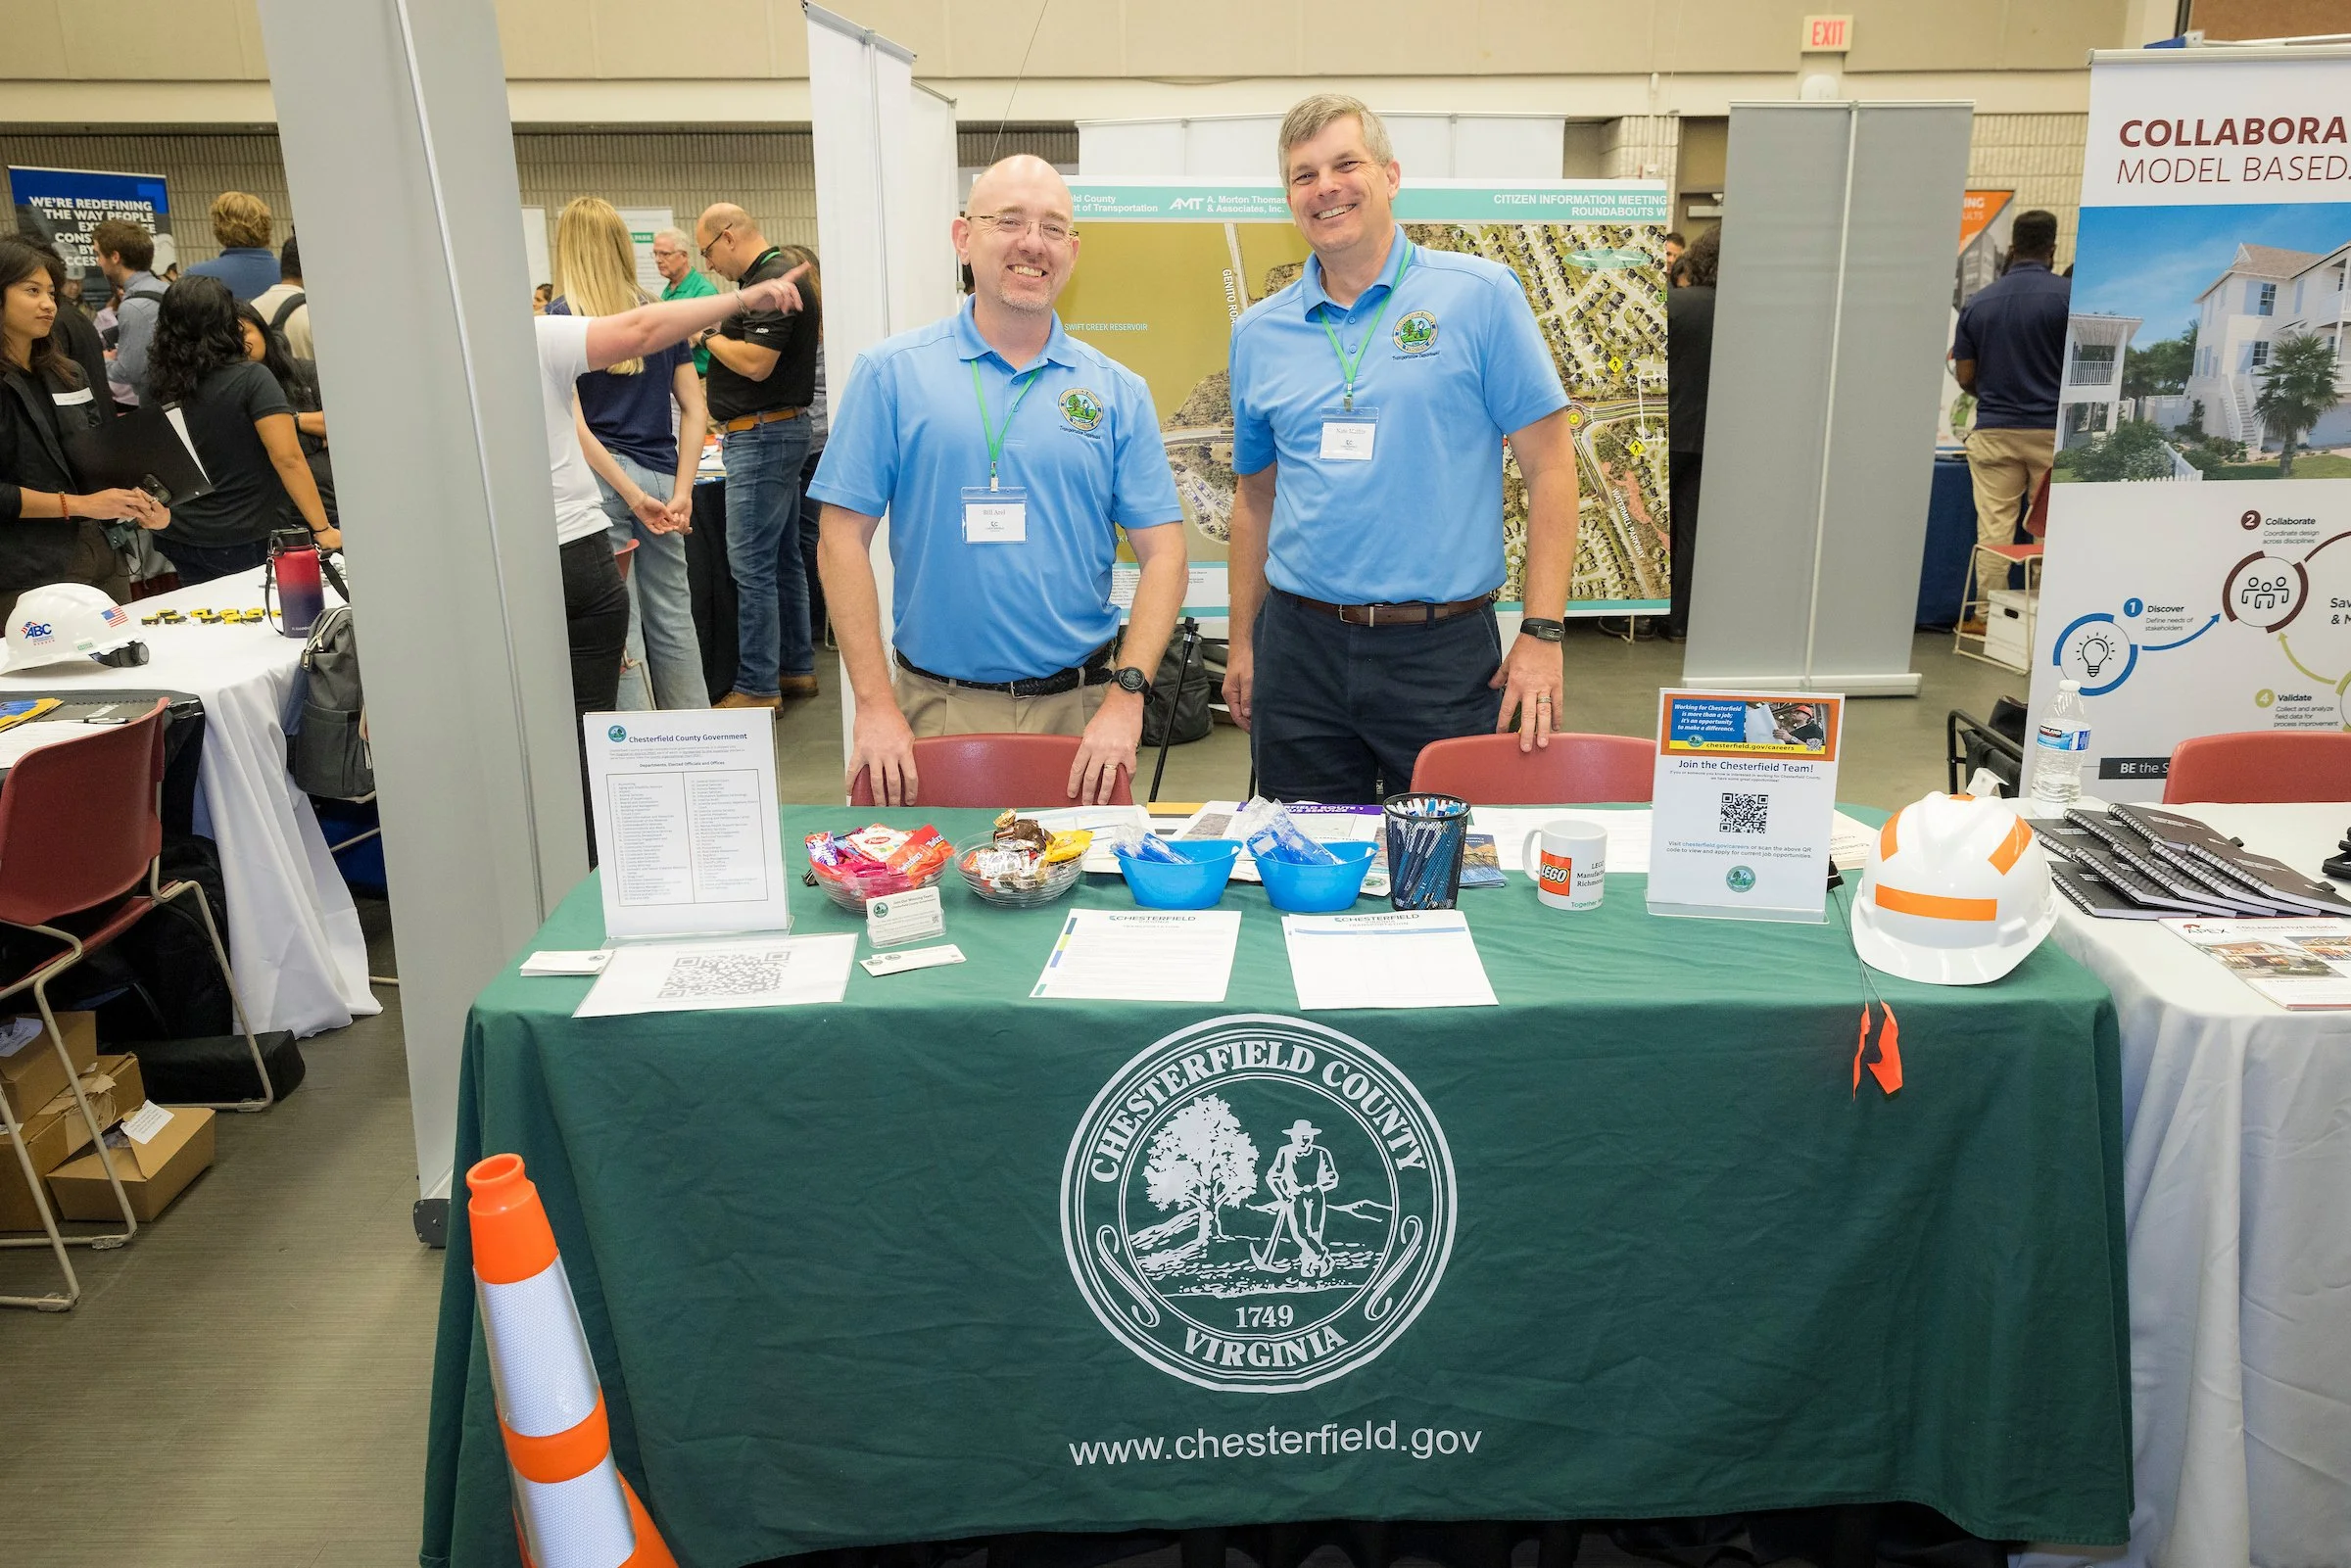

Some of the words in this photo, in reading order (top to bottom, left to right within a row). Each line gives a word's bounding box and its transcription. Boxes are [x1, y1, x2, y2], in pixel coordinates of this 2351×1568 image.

[1812, 21, 1846, 46] EXIT
[2117, 158, 2231, 184] MODEL
[28, 196, 73, 209] WE'RE
[75, 199, 153, 212] REDEFINING
[1085, 195, 1116, 204] County
[1169, 197, 1204, 211] AMT
[1218, 195, 1249, 204] Morton
[1251, 195, 1286, 204] Thomas
[1494, 195, 1537, 204] CITIZEN
[1539, 195, 1614, 205] INFORMATION
[1618, 195, 1666, 205] MEETING
[1083, 203, 1092, 212] of
[1093, 204, 1158, 213] Transportation
[1216, 205, 1268, 214] Associates,
[1571, 207, 1654, 216] ROUNDABOUTS
[43, 209, 72, 219] THE
[73, 210, 104, 221] WAY
[107, 211, 154, 222] PEOPLE
[79, 245, 95, 256] BY
[1222, 268, 1237, 303] GENITO
[1611, 488, 1631, 528] WATERMILL
[1627, 526, 1646, 559] PARKWAY
[2245, 514, 2256, 527] 2
[2265, 517, 2317, 526] Collaborate
[2146, 604, 2184, 614] Discover
[2331, 614, 2340, 625] &
[24, 623, 52, 639] ABC
[2259, 692, 2269, 704] 4
[629, 735, 674, 743] Chesterfield
[675, 735, 701, 744] County
[702, 733, 747, 741] Government
[1705, 742, 1795, 751] chesterfield.gov/careers
[1678, 760, 1698, 769] Join
[1701, 760, 1717, 770] the
[1720, 761, 1779, 772] Chesterfield
[1782, 763, 1813, 773] Team!
[2120, 762, 2135, 774] BE
[2139, 762, 2159, 774] the
[1541, 863, 1567, 883] LEGO
[1571, 900, 1598, 909] Together
[1342, 914, 1420, 923] CHESTERFIELD
[1090, 1040, 1316, 1183] CHESTERFIELD
[1321, 1060, 1426, 1171] COUNTY
[1235, 1305, 1294, 1328] 1749
[1183, 1326, 1348, 1367] VIRGINIA
[1069, 1420, 1482, 1466] www.chesterfield.gov
